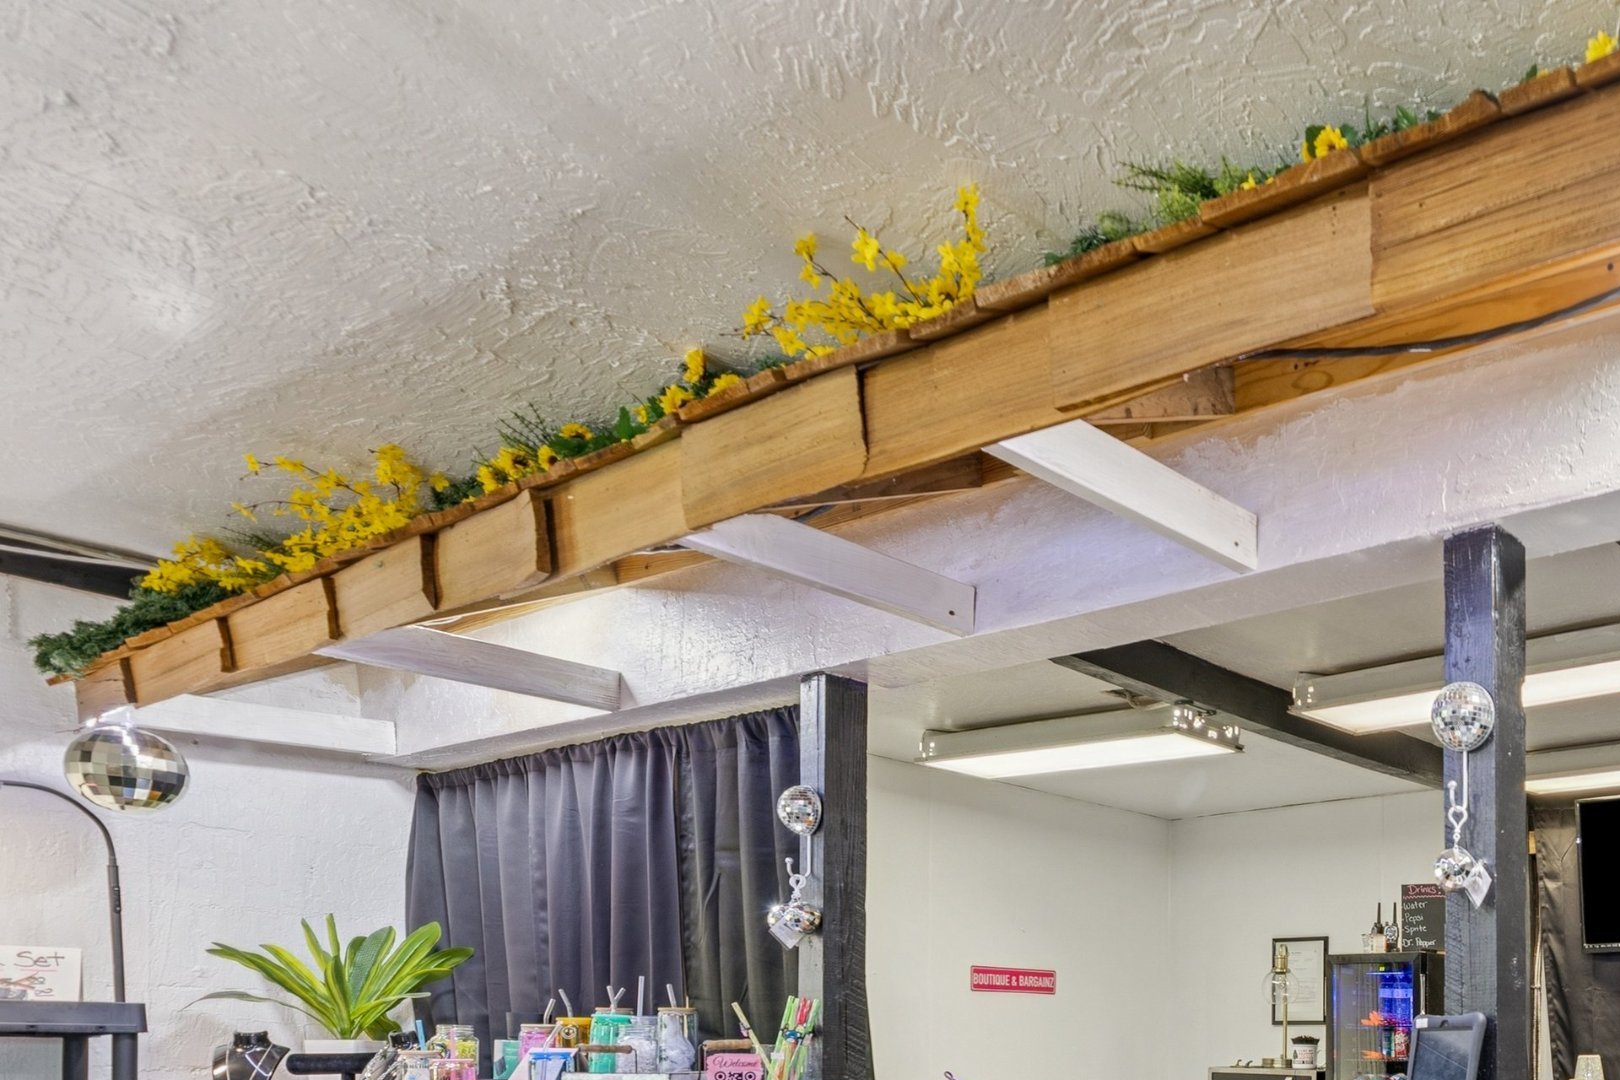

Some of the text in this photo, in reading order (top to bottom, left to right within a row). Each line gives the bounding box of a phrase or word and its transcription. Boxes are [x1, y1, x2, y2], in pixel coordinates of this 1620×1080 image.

[13, 950, 65, 967] Set
[973, 973, 1054, 988] BOUTIQUE & BARGAINZ
[713, 1056, 758, 1068] Welcome
